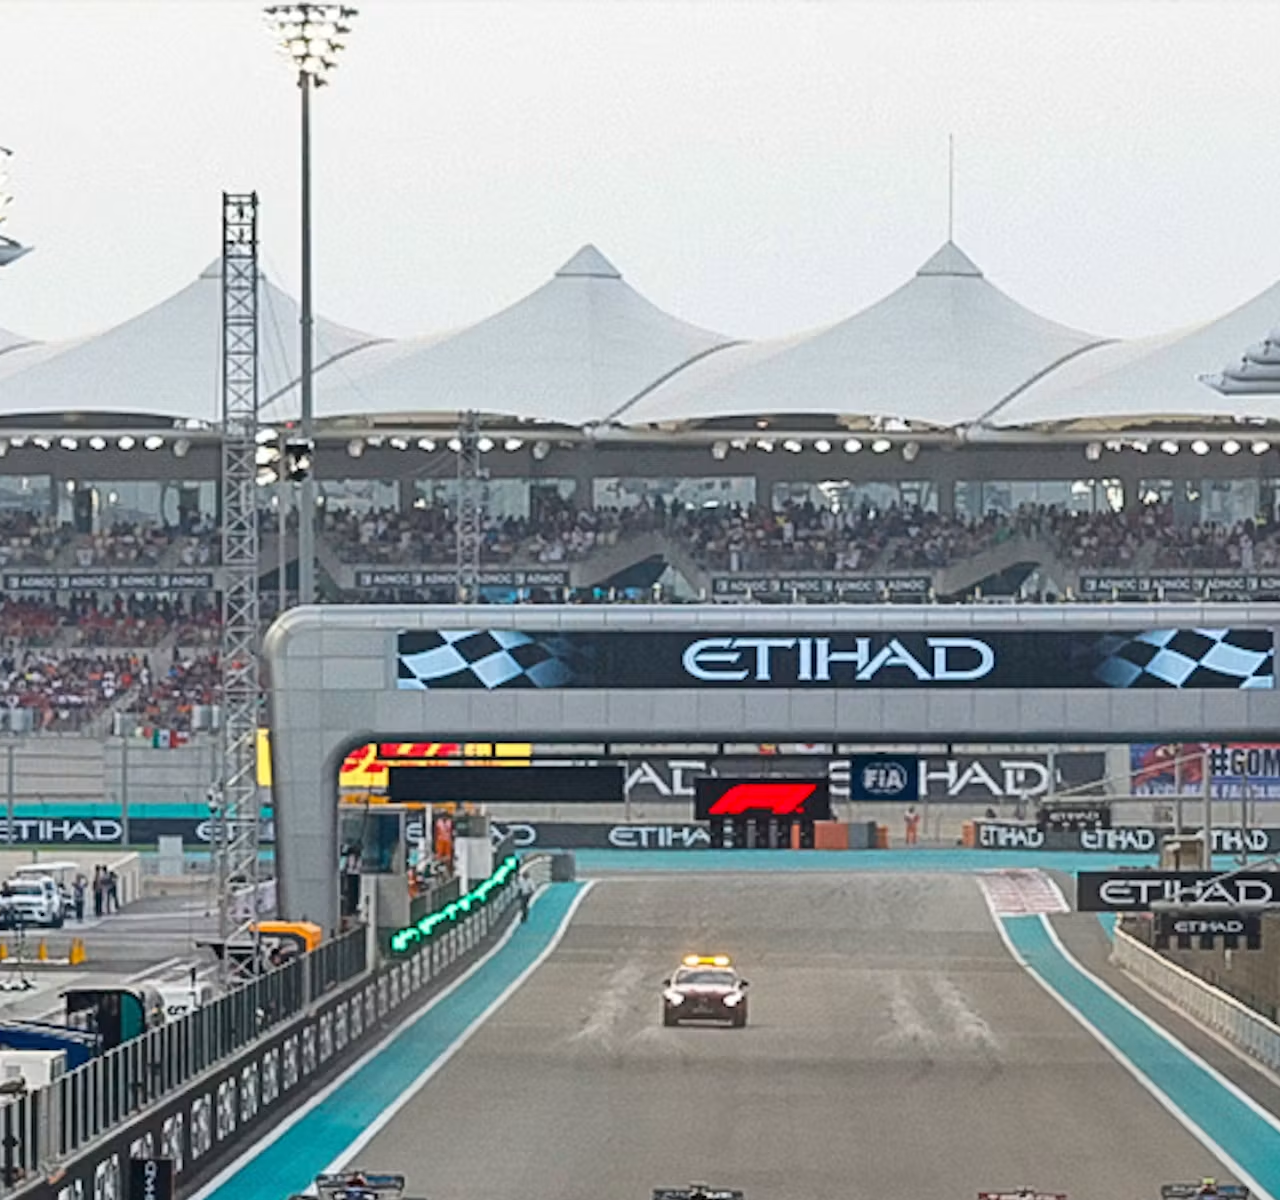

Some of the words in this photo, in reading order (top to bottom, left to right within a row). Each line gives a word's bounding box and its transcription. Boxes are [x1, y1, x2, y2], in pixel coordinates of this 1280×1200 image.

[20, 575, 57, 588] ADNOC
[71, 575, 106, 588] ADNOC
[121, 575, 156, 588] ADNOC
[1097, 578, 1137, 590] ADNOC
[1152, 578, 1190, 590] ADNOC
[1206, 578, 1245, 590] ADNOC
[681, 636, 995, 682] ETIHAD
[863, 769, 904, 790] FIA
[608, 826, 712, 847] ETIHA
[980, 825, 1045, 847] ETIHAD
[1081, 829, 1155, 850] ETIHAD
[1205, 829, 1268, 850] TIHAD
[1098, 880, 1273, 905] ETIHAD
[1173, 920, 1244, 933] ETIHAD
